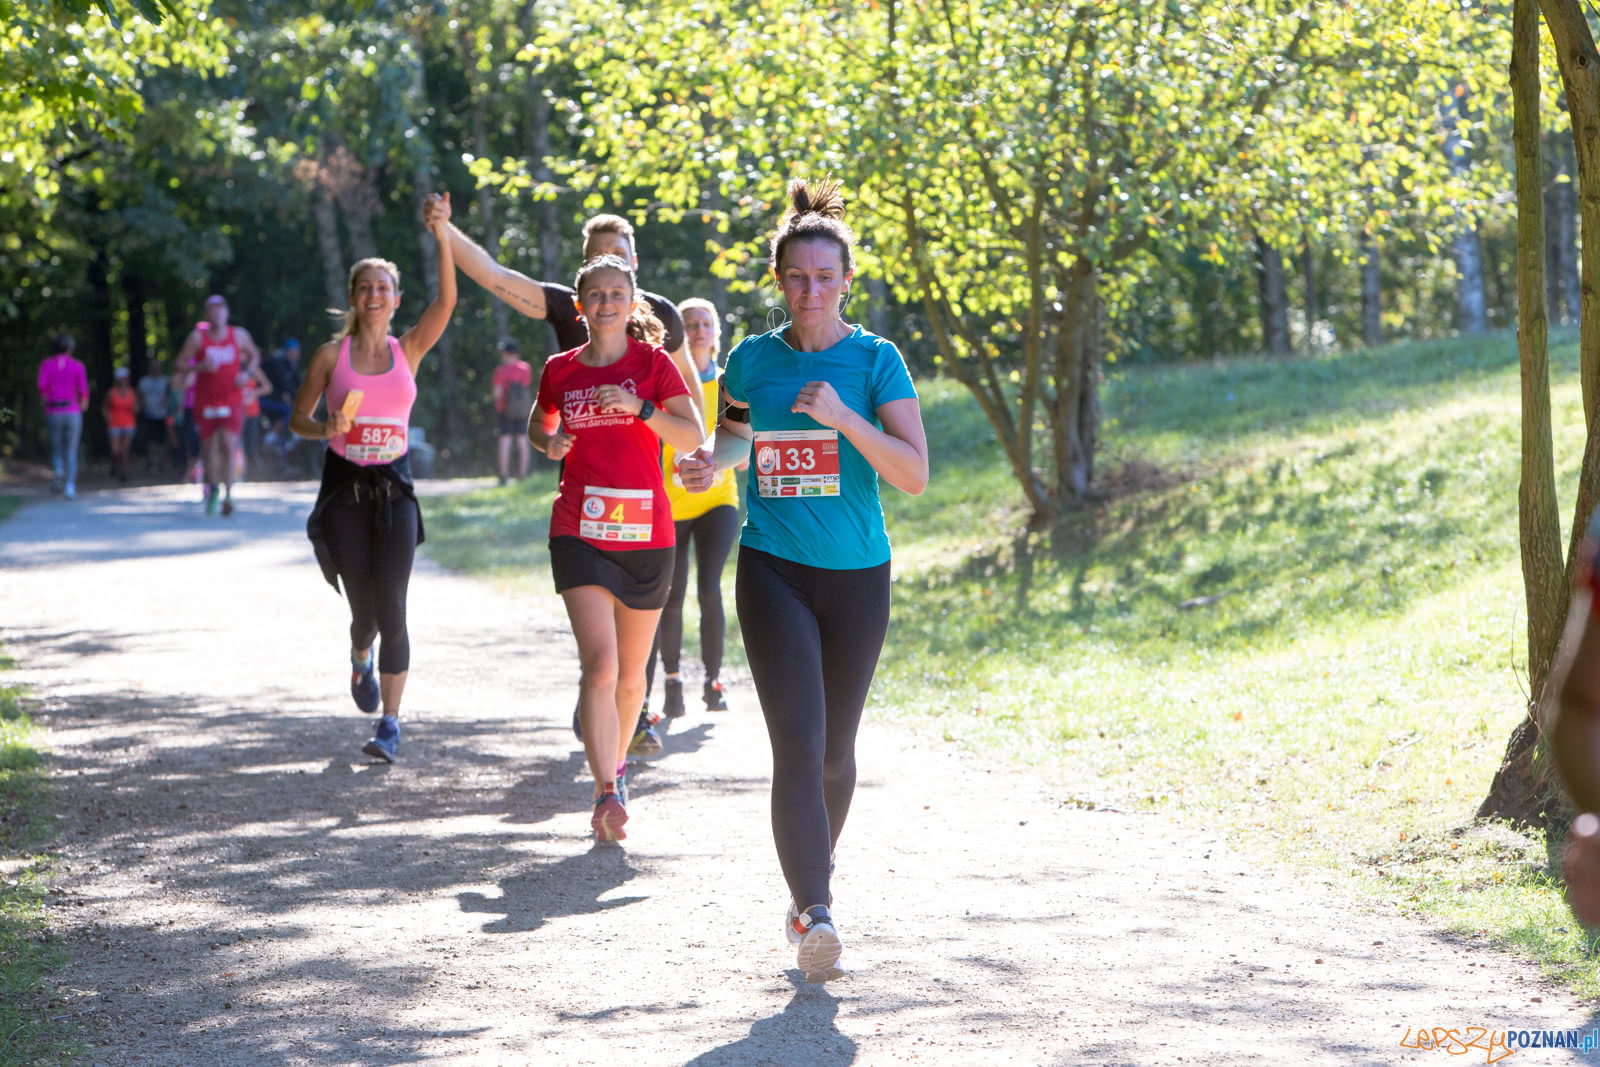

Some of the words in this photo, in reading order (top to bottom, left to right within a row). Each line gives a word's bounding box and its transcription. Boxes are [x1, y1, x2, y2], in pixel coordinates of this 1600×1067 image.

[362, 427, 392, 445] 587
[774, 447, 816, 471] 133
[609, 503, 624, 524] 4
